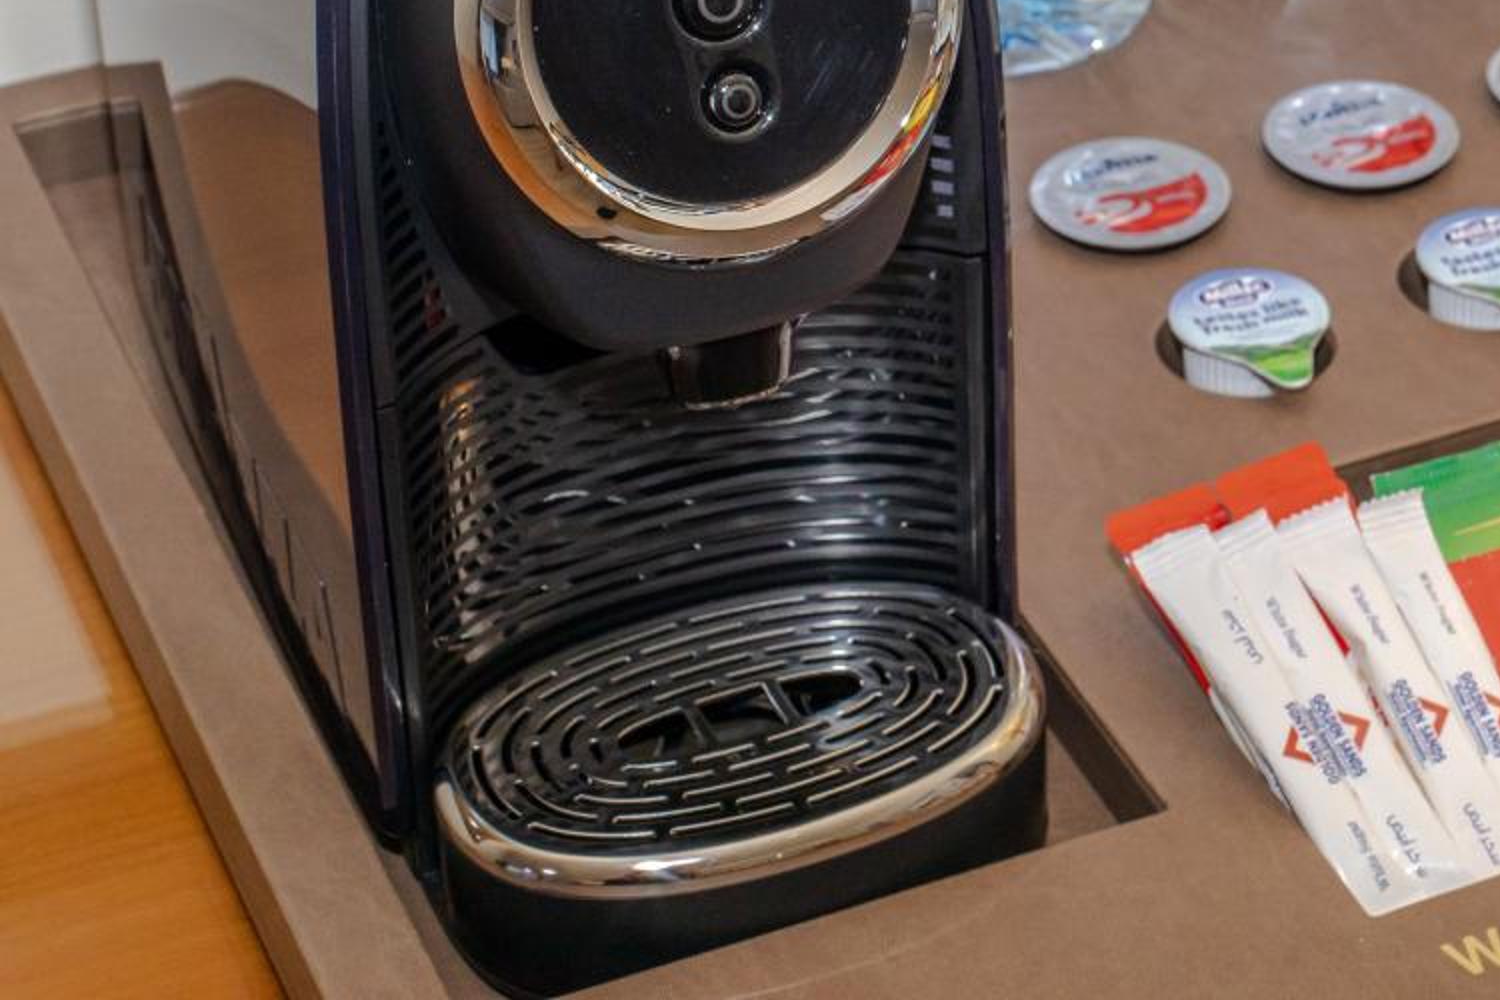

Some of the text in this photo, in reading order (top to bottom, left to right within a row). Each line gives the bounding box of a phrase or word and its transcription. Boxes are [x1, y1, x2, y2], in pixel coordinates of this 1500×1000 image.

[1309, 692, 1369, 778] GOLDEN SANDS
[1392, 676, 1448, 765] GOLDEN SANDS
[1456, 670, 1493, 719] GOLDEN
